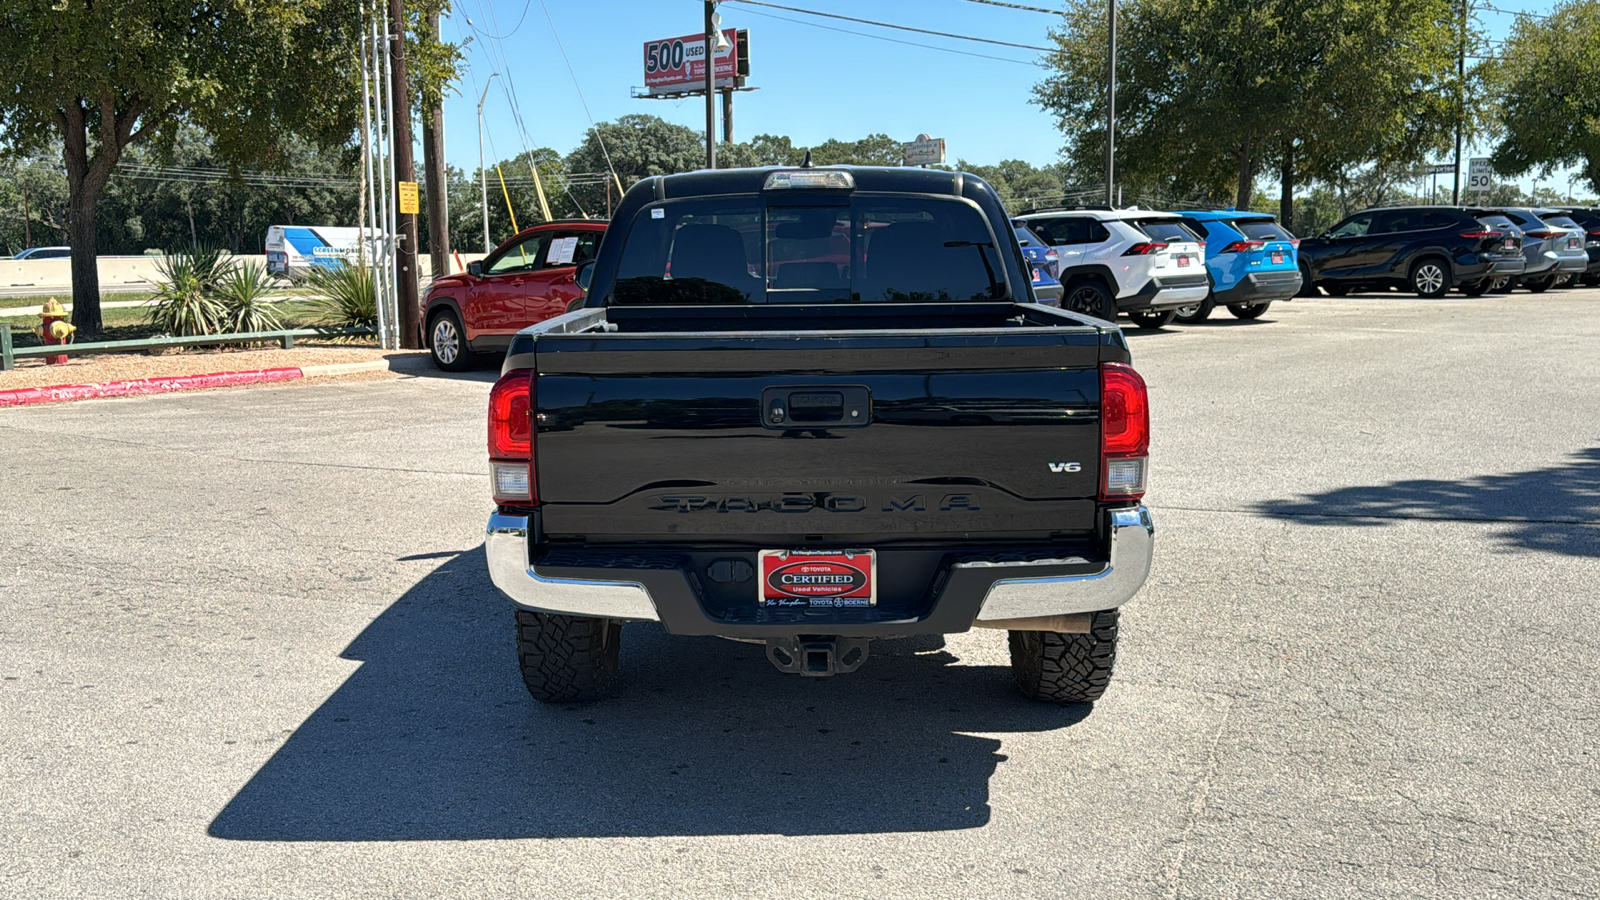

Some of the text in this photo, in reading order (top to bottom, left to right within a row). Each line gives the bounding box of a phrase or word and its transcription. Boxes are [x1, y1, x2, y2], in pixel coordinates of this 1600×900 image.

[646, 39, 704, 73] 500 USED
[1471, 175, 1489, 187] 50
[792, 396, 838, 405] TOYOTA
[1048, 461, 1082, 473] V6
[660, 493, 980, 513] TACOMA
